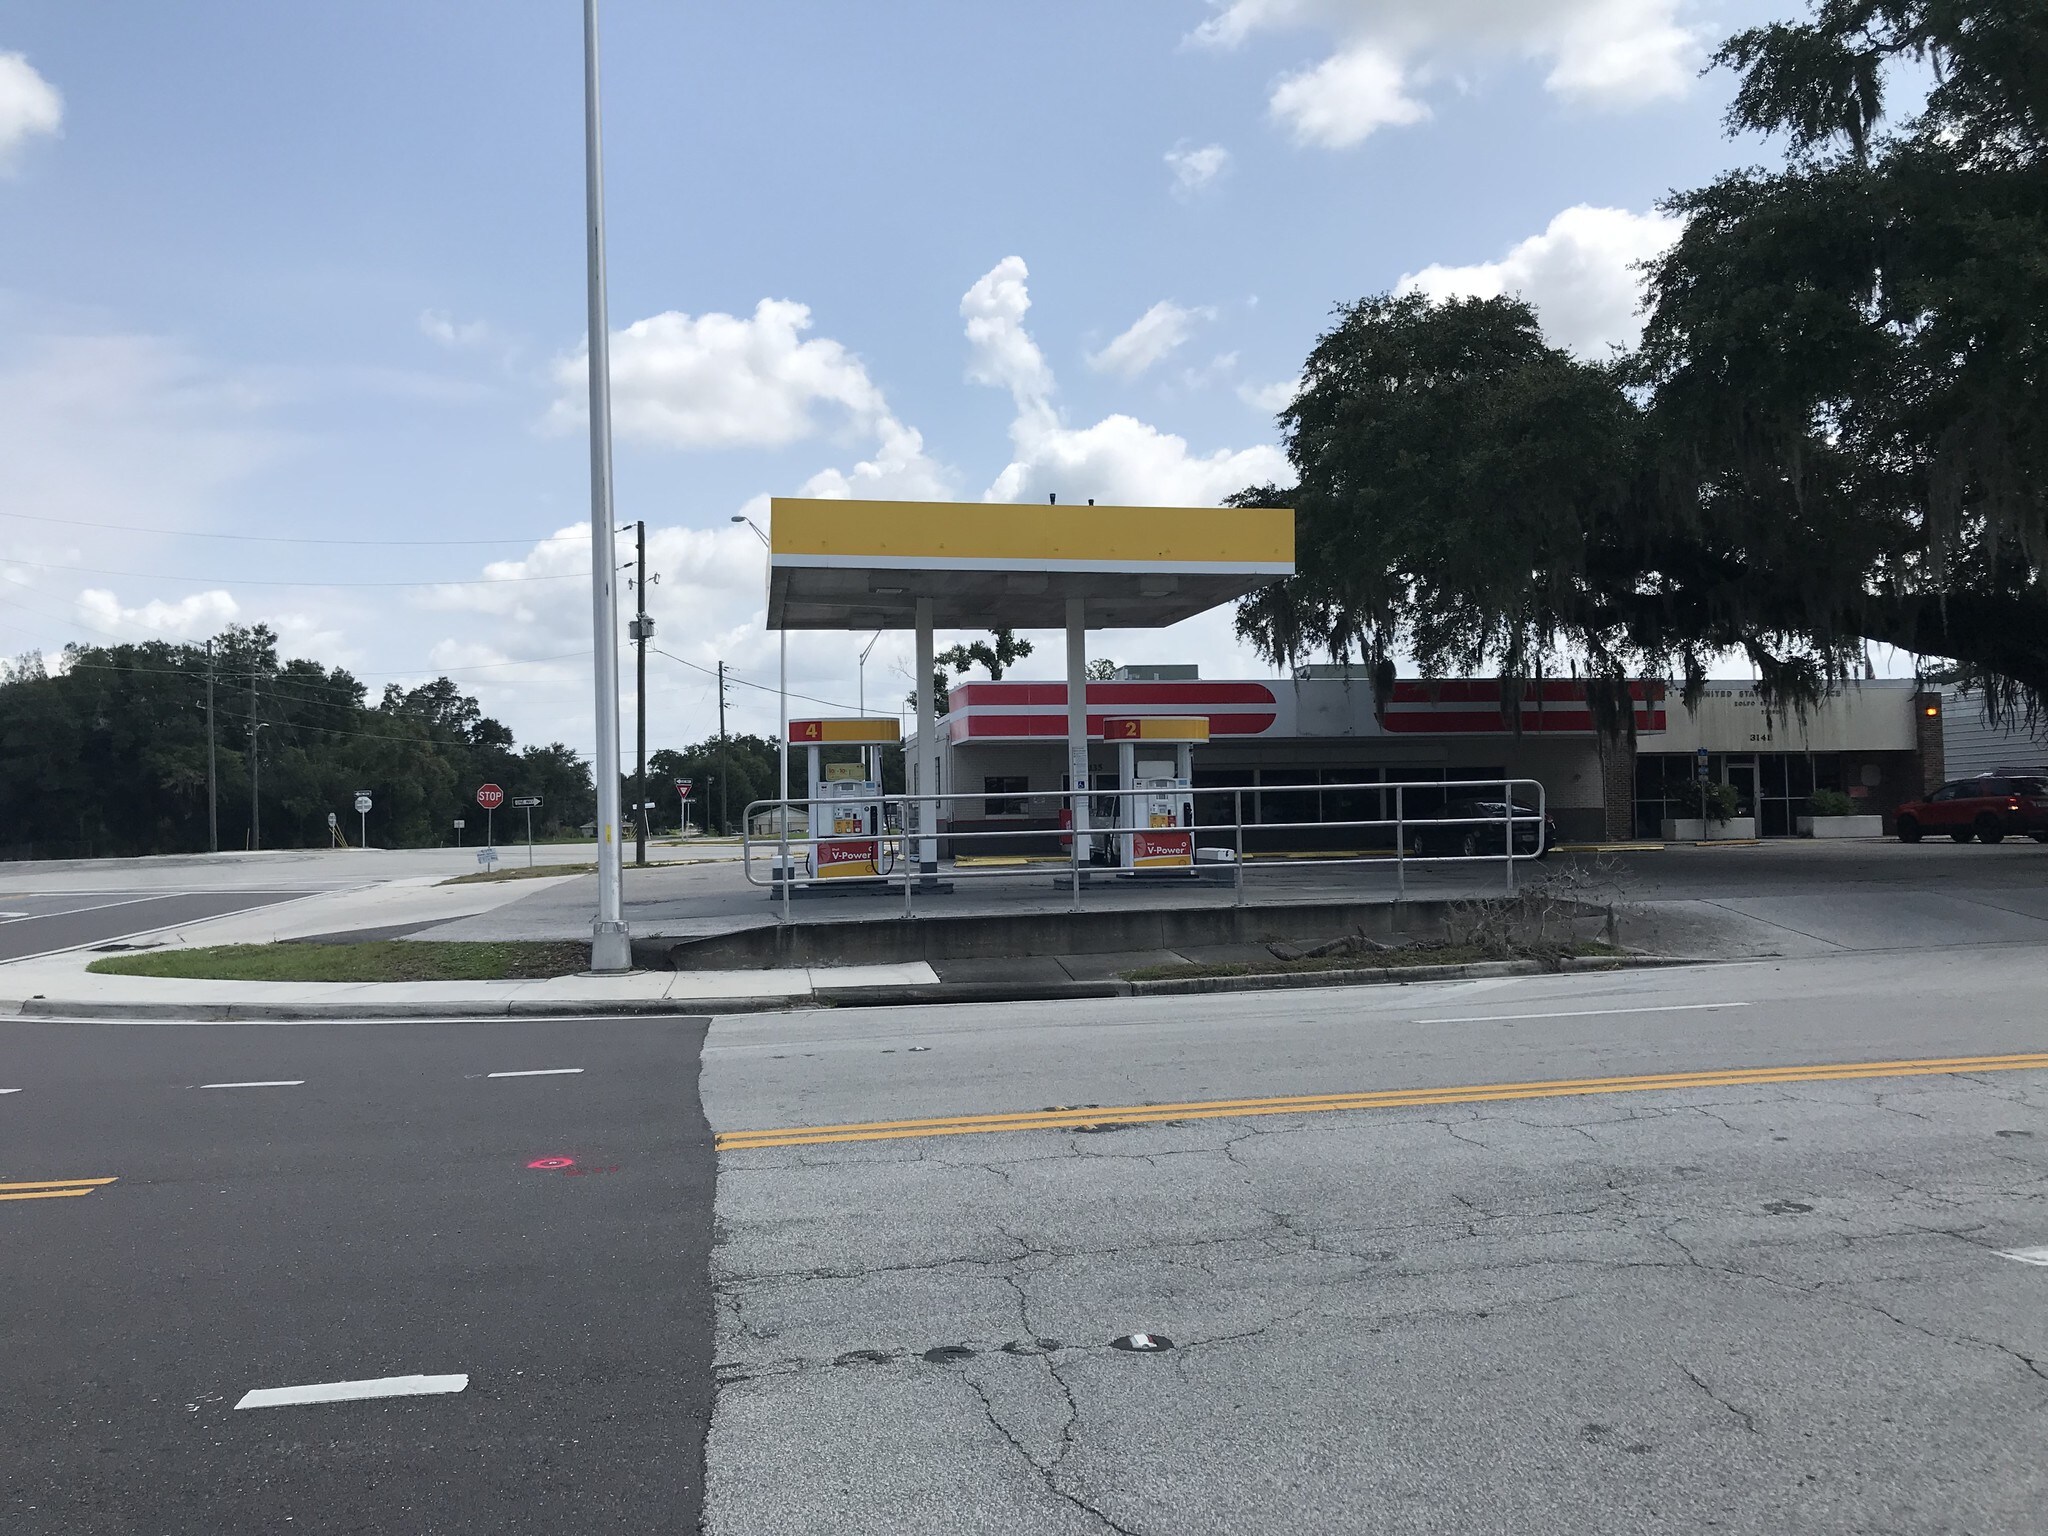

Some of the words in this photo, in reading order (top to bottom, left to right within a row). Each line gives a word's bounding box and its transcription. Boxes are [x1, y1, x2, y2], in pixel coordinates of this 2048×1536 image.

[1703, 690, 1733, 698] NITED
[806, 724, 817, 738] 4
[1126, 722, 1137, 736] 2
[479, 791, 502, 801] STOP
[1147, 846, 1185, 854] V-Power
[832, 851, 872, 860] V-Power
